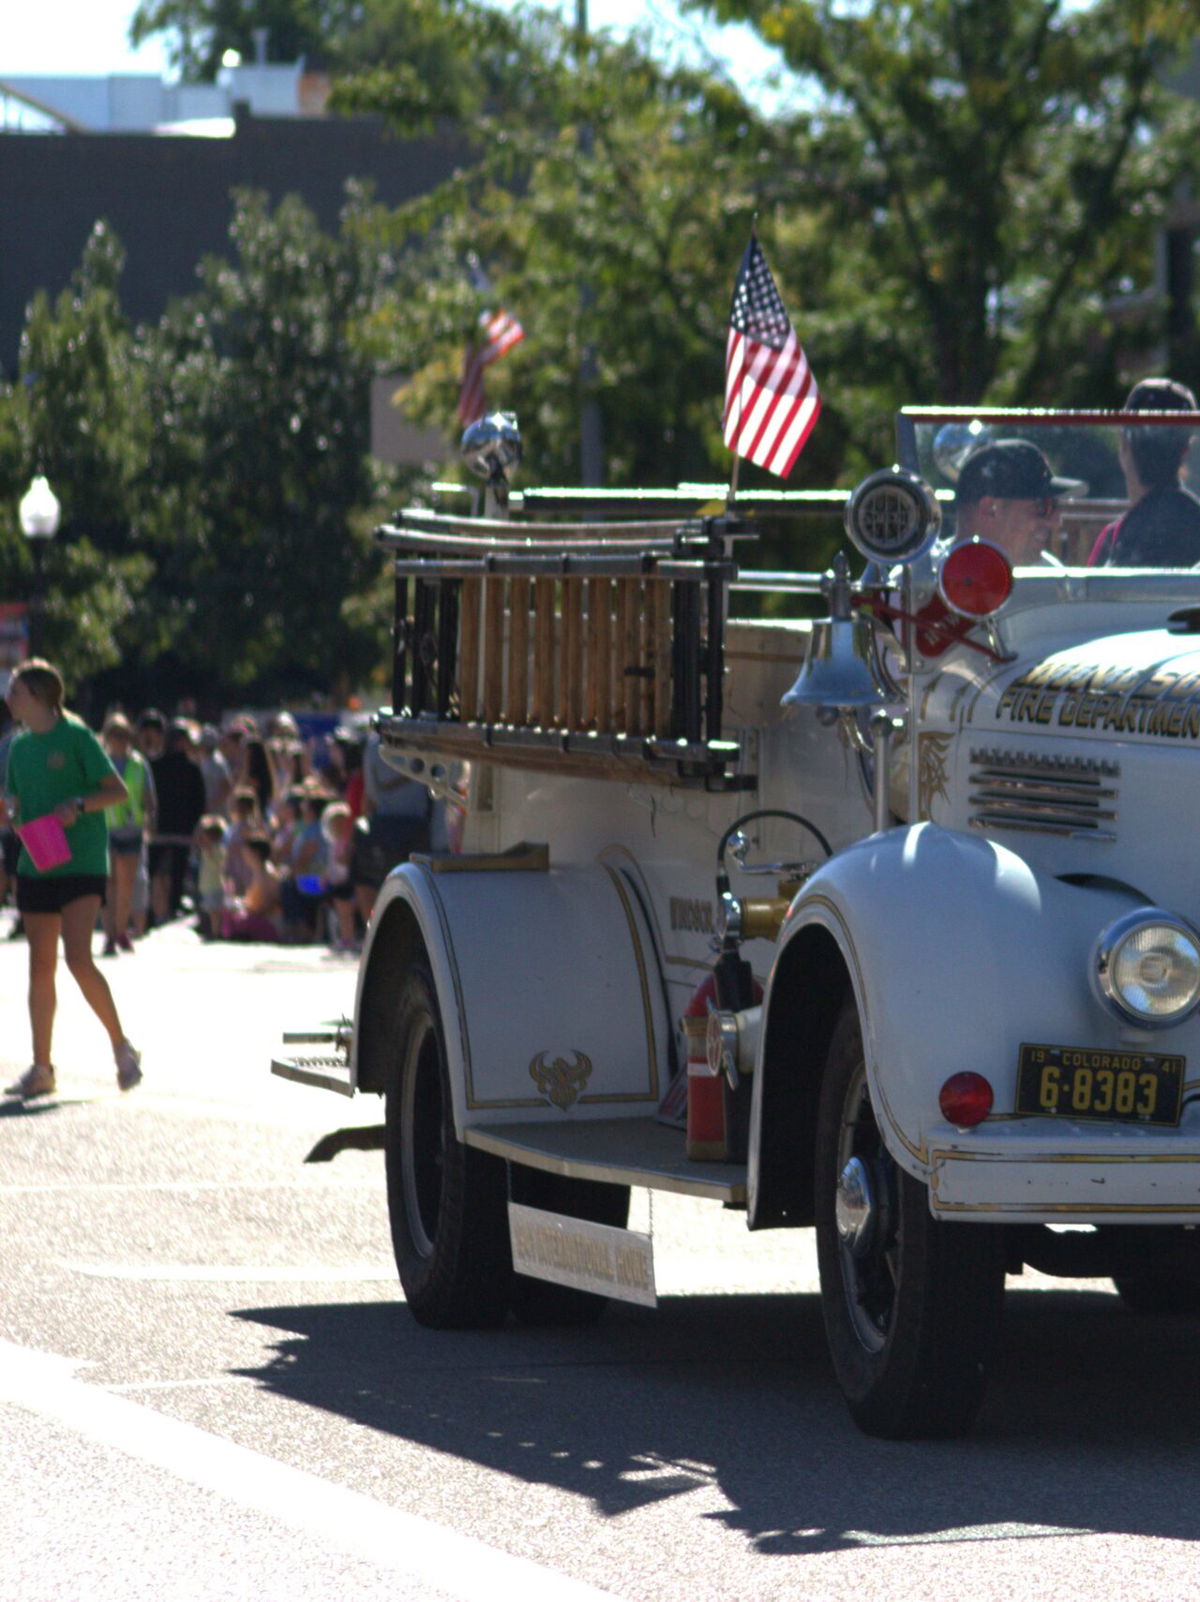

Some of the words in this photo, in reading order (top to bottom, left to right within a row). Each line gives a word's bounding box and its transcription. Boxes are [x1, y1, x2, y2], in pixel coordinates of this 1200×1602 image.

[995, 684, 1056, 726] FIRE
[1030, 1049, 1046, 1064] 19
[1061, 1052, 1142, 1072] COLORADO
[1161, 1060, 1177, 1074] 41
